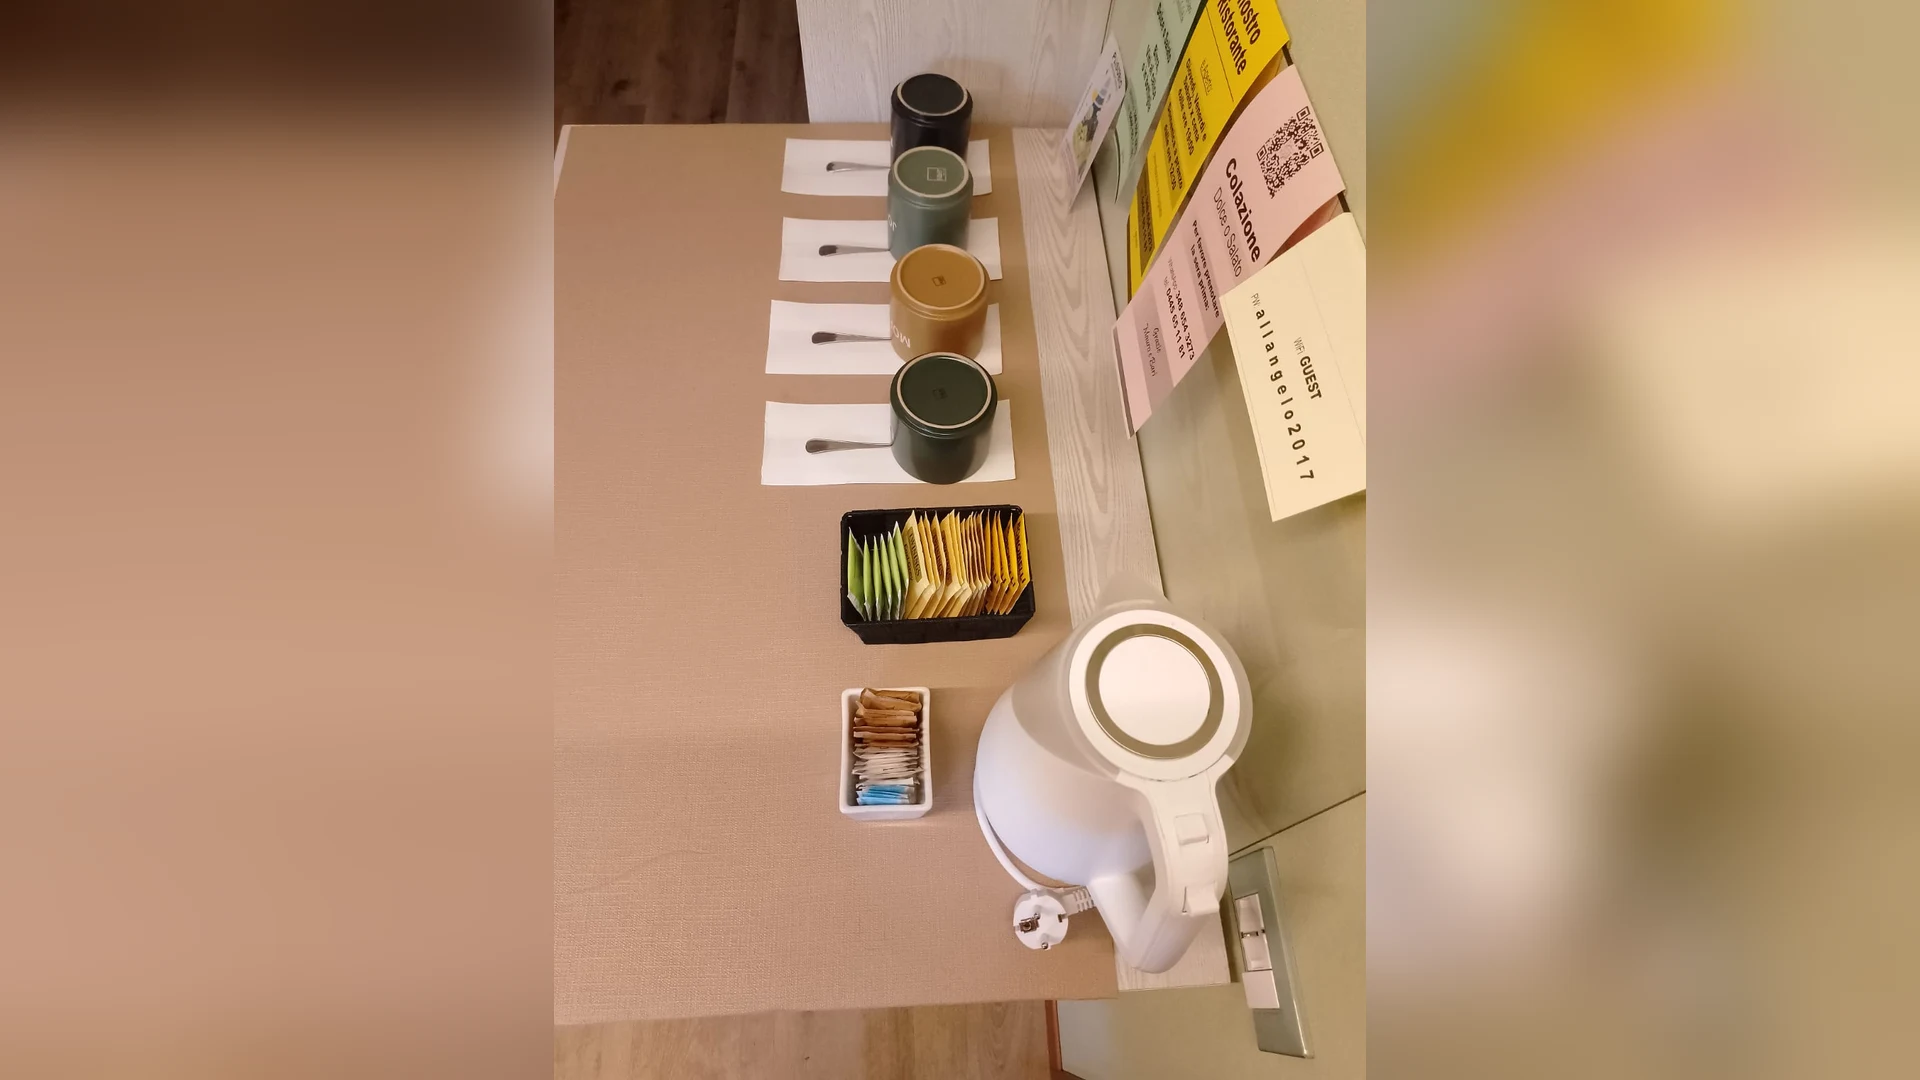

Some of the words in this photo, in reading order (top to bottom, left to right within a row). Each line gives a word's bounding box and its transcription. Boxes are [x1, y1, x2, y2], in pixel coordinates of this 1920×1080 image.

[1213, 187, 1228, 226] Dolce
[1226, 158, 1261, 262] Colazione
[1191, 244, 1196, 256] la
[1224, 225, 1231, 237] o
[1193, 257, 1202, 278] sera
[1227, 233, 1242, 277] Salato
[1197, 237, 1207, 269] favore
[1204, 270, 1220, 318] prenotare
[890, 321, 911, 348] MO
[1166, 288, 1175, 313] 0445
[1176, 329, 1182, 343] 11
[1179, 344, 1185, 358] 81
[1176, 290, 1184, 311] 348
[1184, 332, 1195, 360] 3273
[1300, 356, 1322, 400] GUEST
